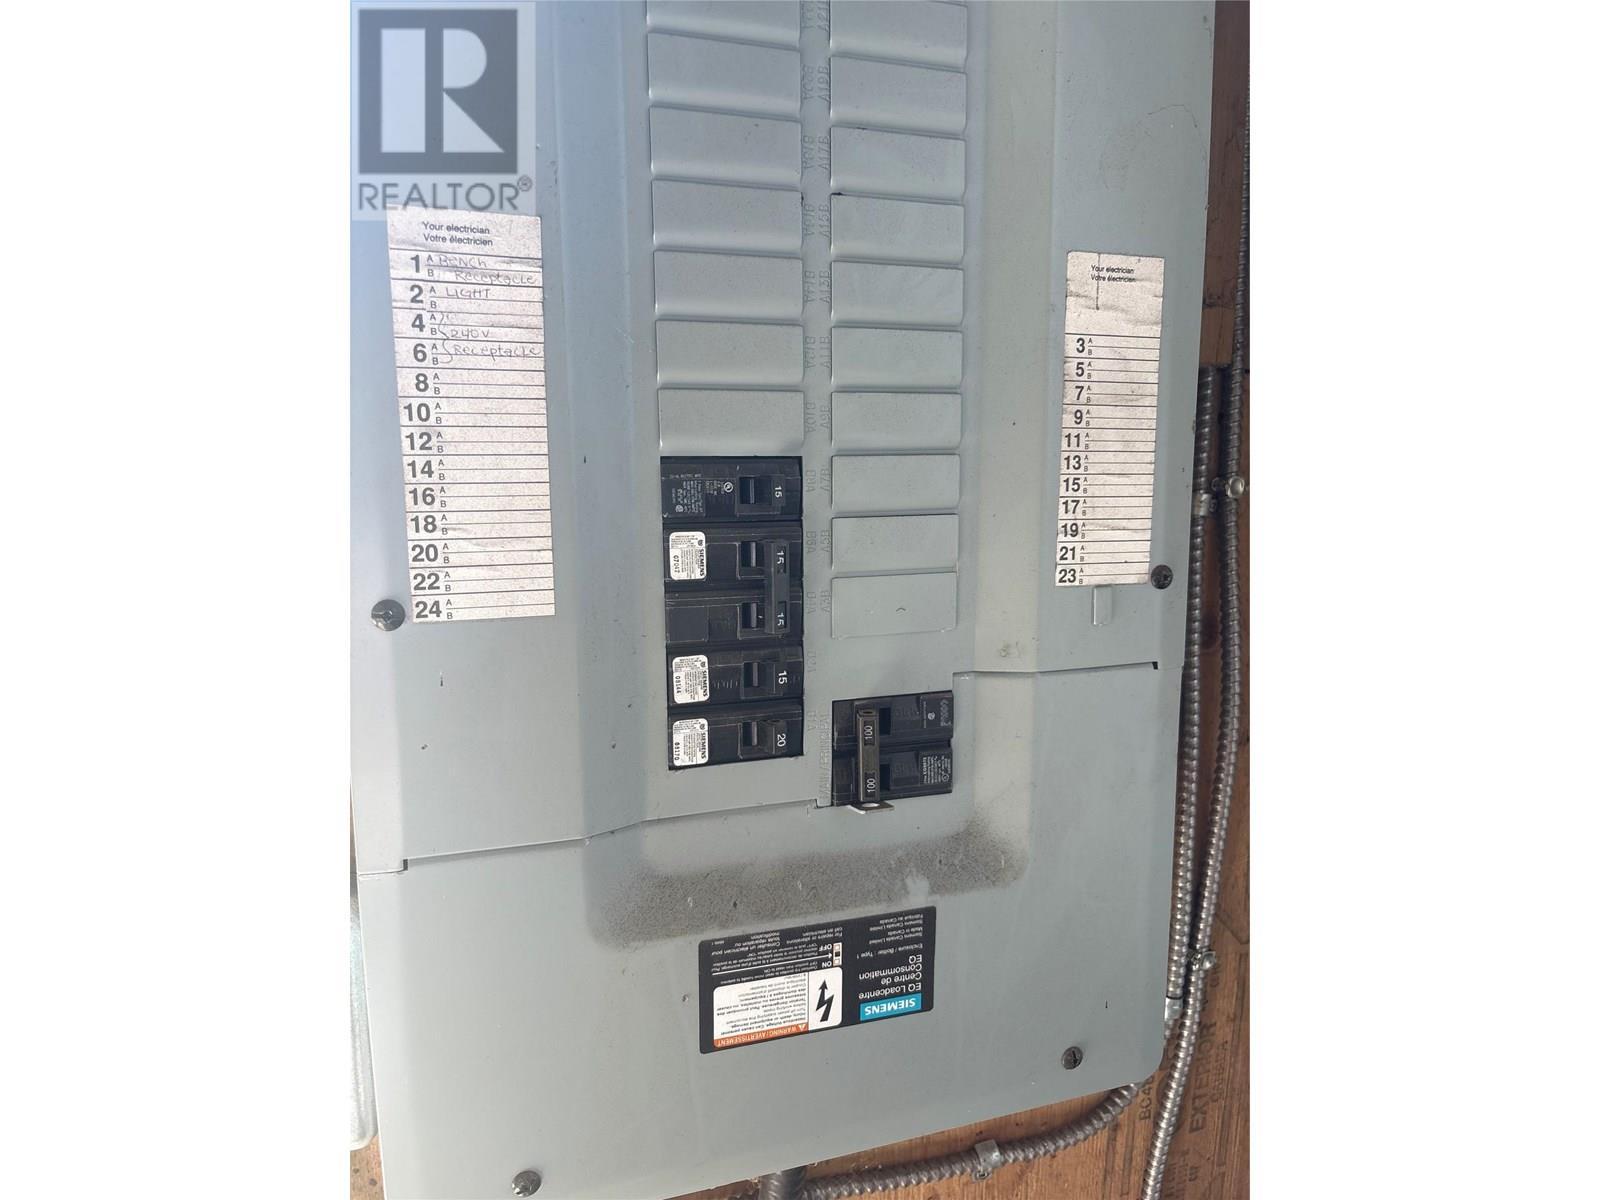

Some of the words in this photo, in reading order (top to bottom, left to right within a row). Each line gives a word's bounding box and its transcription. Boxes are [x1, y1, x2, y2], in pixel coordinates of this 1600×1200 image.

[423, 221, 444, 231] Your
[447, 225, 490, 234] electrician
[424, 234, 447, 243] Votre
[449, 236, 493, 246] électricien
[411, 255, 419, 273] 1
[1091, 265, 1105, 274] Your
[1106, 266, 1134, 274] electrician
[1090, 274, 1106, 282] Votre
[1107, 275, 1135, 283] électricien
[410, 285, 423, 303] 2
[412, 314, 425, 332] 4
[414, 343, 427, 362] 6
[1077, 338, 1085, 353] 3
[1076, 362, 1084, 377] 5
[415, 373, 429, 392] 8
[1075, 386, 1084, 400] 7
[404, 403, 430, 422] 10
[1075, 410, 1083, 424] 9
[406, 432, 432, 450] 12
[1065, 433, 1080, 447] 11
[407, 460, 434, 478] 14
[1064, 455, 1081, 470] 13
[774, 485, 782, 498] 15
[1064, 478, 1080, 492] 15
[409, 488, 435, 505] 16
[1062, 500, 1079, 514] 17
[411, 515, 437, 533] 18
[1062, 523, 1078, 537] 19
[412, 544, 438, 562] 20
[1060, 546, 1075, 560] 21
[414, 573, 440, 590] 22
[1059, 569, 1076, 583] 23
[415, 601, 441, 618] 24
[778, 670, 788, 684] 15
[777, 733, 787, 747] 20
[864, 725, 873, 740] 100
[867, 778, 875, 793] 100
[909, 954, 922, 964] EQ
[859, 964, 922, 980] Consommation
[894, 971, 922, 983] Centre
[881, 977, 891, 985] de
[908, 982, 921, 991] EQ
[858, 984, 906, 999] Loadcentre
[865, 998, 916, 1015] SIEMENS
